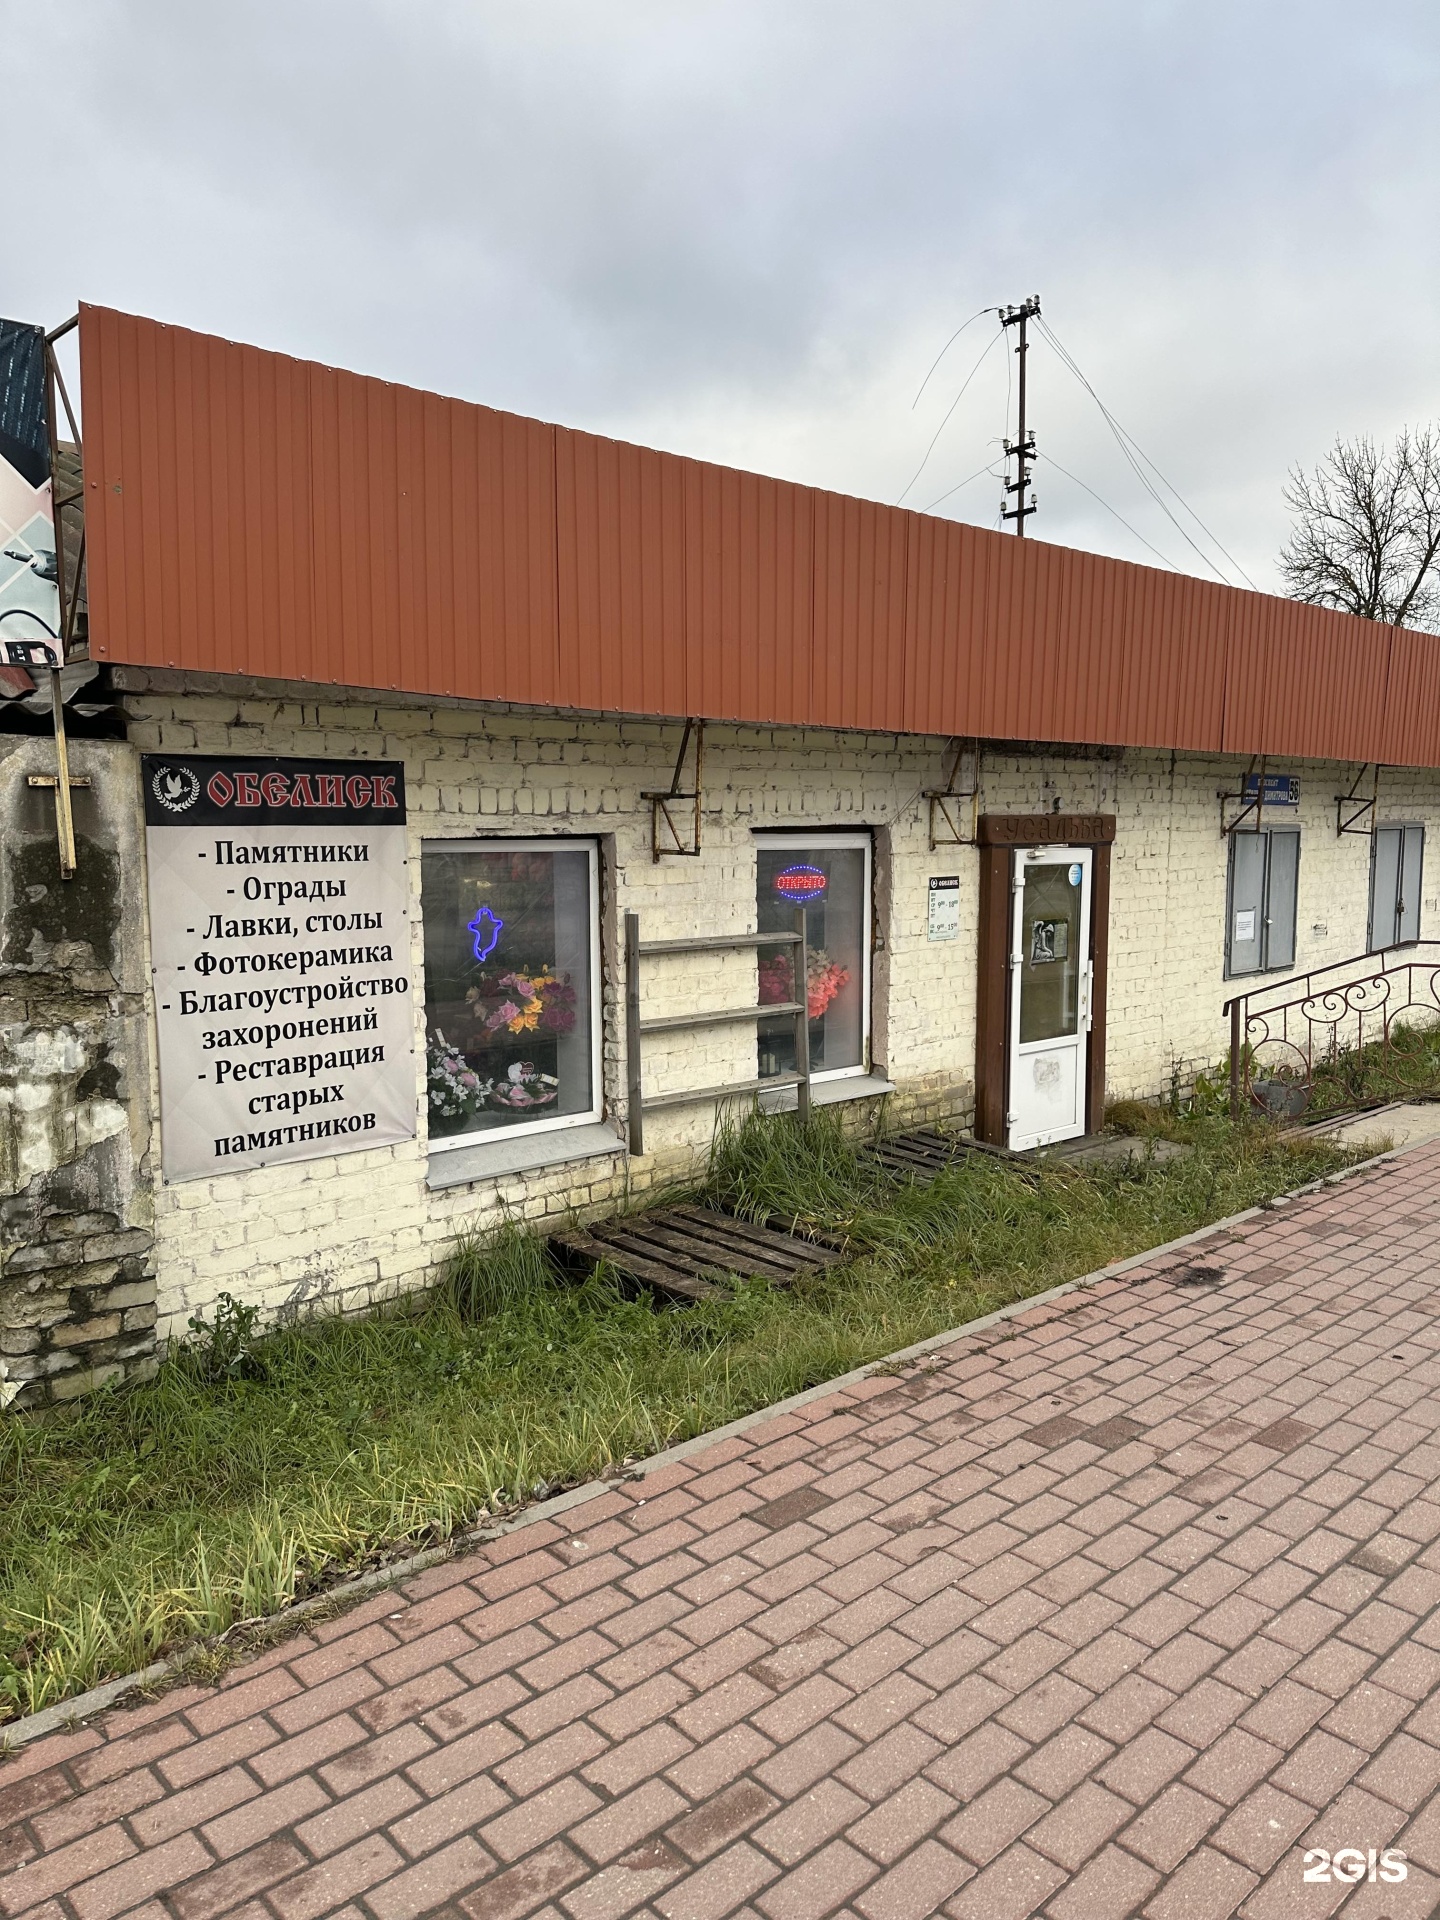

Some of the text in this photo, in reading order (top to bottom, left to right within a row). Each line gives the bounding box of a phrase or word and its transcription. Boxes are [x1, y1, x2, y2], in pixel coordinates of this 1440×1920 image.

[207, 771, 398, 809] ОБЕЛИСК
[1003, 817, 1106, 841] УСАДЬБА
[215, 840, 369, 865] Памятники
[243, 877, 346, 905] Ограды
[777, 875, 826, 889] ОТКРЫТО
[203, 914, 299, 940] Лавки,
[305, 912, 383, 933] столы
[194, 944, 393, 977] Фотокерамика
[180, 976, 409, 1015] Благоустройство
[202, 1007, 378, 1050] захоронений
[215, 1045, 385, 1084] Реставрация
[248, 1084, 344, 1115] старых
[214, 1112, 376, 1156] памятников
